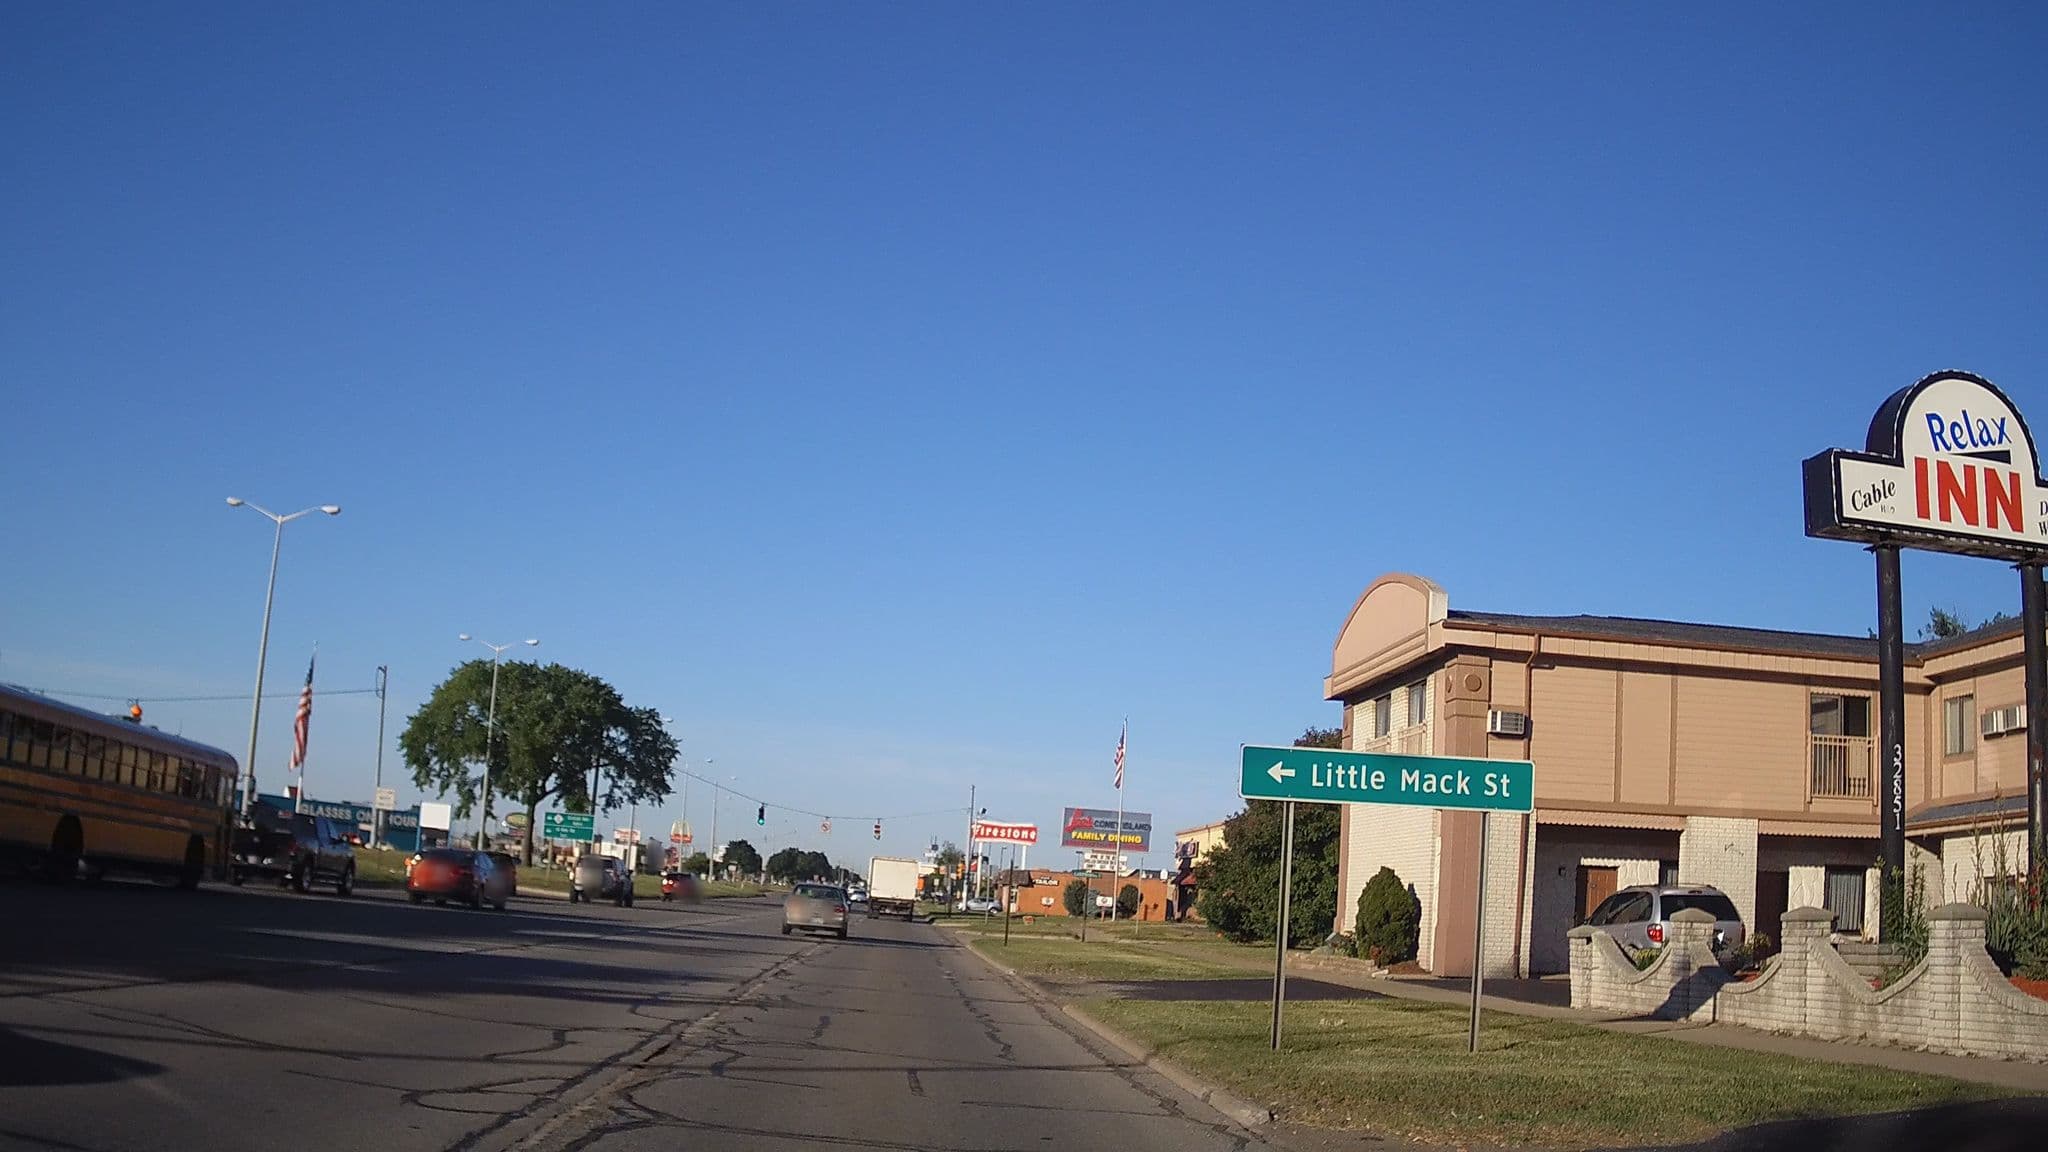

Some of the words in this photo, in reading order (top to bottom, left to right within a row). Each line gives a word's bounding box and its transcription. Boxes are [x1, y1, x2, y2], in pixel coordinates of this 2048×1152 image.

[1926, 409, 2012, 452] Relax
[1851, 478, 1896, 512] Cable
[1914, 456, 2024, 533] INN
[1311, 762, 1386, 790] Little
[1400, 768, 1470, 795] Mack
[1483, 773, 1511, 797] St
[1893, 743, 1902, 830] 32851
[300, 803, 352, 821] GLASSES
[971, 824, 1037, 840] Firestone
[1071, 831, 1106, 842] FAMILY
